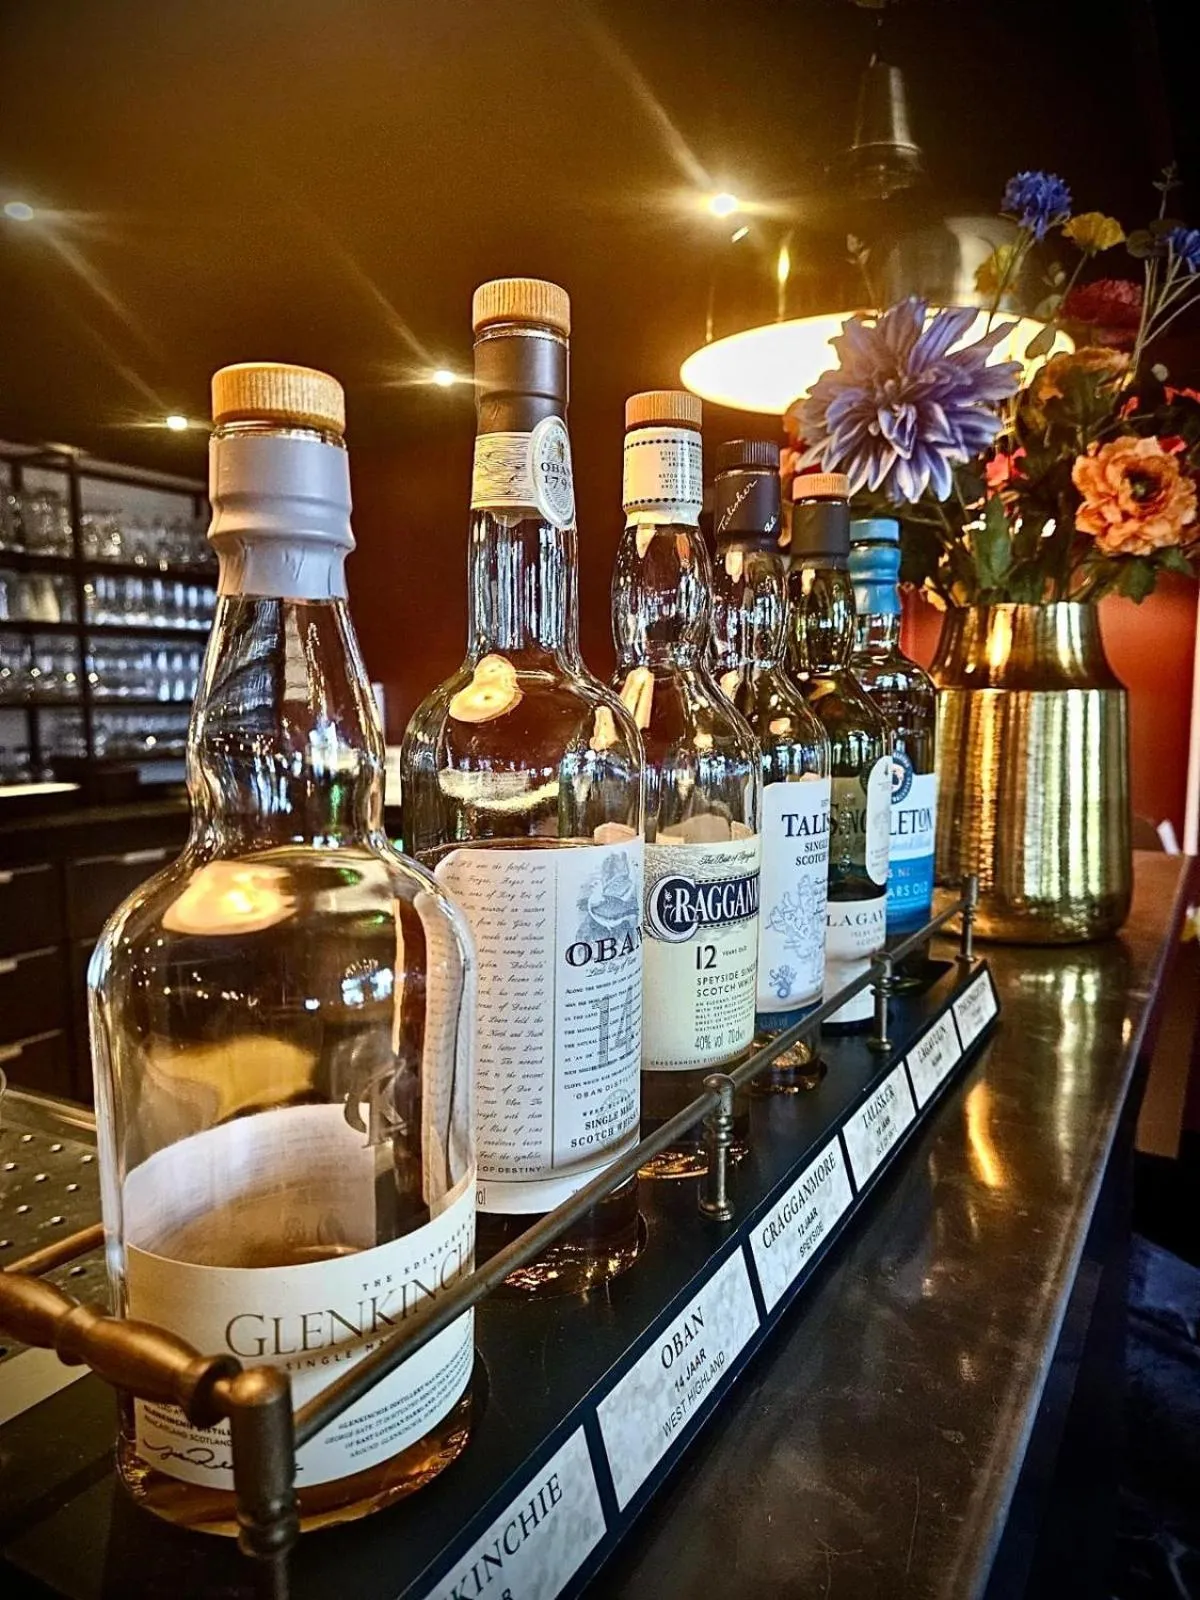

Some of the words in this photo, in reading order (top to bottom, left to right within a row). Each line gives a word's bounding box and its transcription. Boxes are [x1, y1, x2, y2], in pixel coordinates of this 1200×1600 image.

[696, 944, 717, 970] 12
[696, 970, 739, 986] SPEYSIDE
[696, 982, 736, 998] SCOTCH
[584, 1111, 619, 1131] SINGLE
[570, 1125, 615, 1149] SCOTCH
[761, 1151, 837, 1250] CRAGGANMORE
[804, 1206, 819, 1231] JAAR
[799, 1220, 825, 1259] SPEYSIDE
[362, 1273, 394, 1293] THE
[660, 1305, 706, 1370] OBAN
[286, 1353, 353, 1372] SINGLE
[674, 1377, 685, 1393] 14
[685, 1347, 708, 1382] JAAR
[662, 1405, 688, 1439] WEST
[687, 1350, 726, 1403] HIGHLAND
[446, 1472, 563, 1600] KINCHIE
